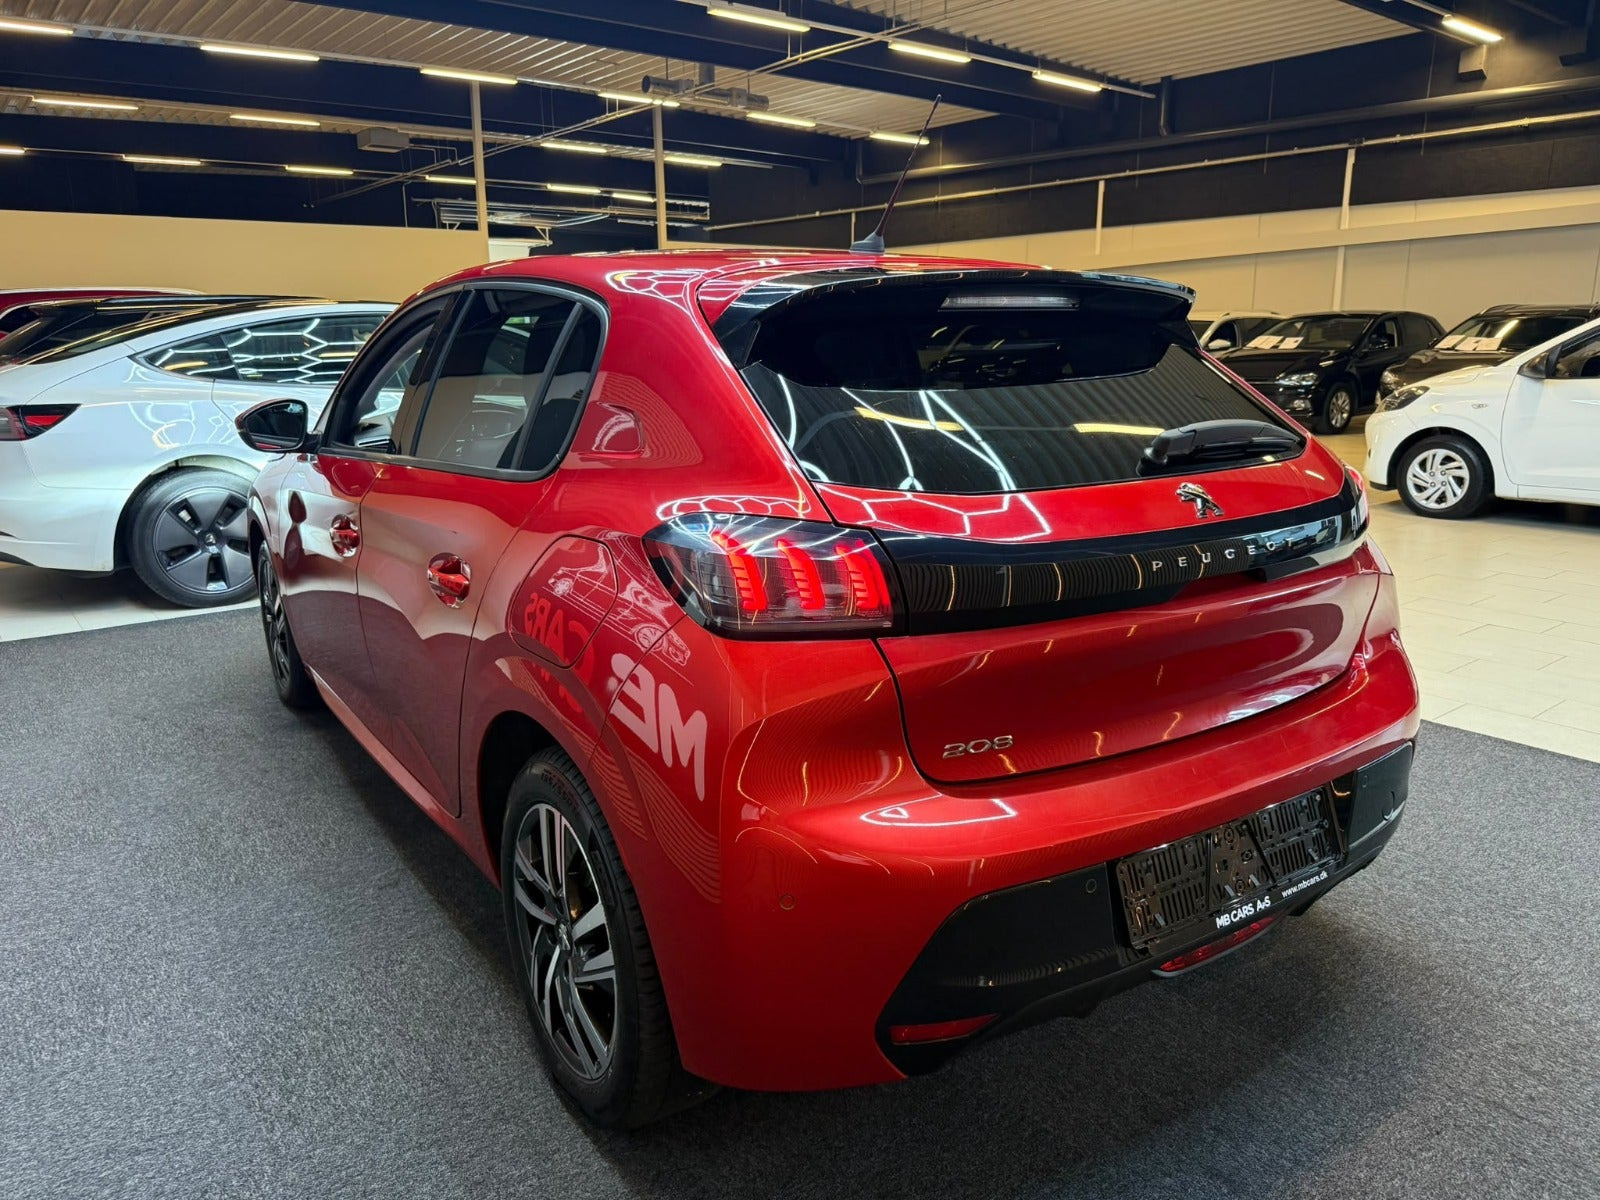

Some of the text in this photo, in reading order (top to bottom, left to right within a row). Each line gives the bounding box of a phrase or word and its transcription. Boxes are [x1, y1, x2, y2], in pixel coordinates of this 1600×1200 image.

[1152, 537, 1294, 572] PEUGEOT
[942, 734, 1013, 759] 208
[1282, 870, 1328, 898] www.mbcars.dk
[1215, 914, 1231, 929] MB
[1231, 904, 1255, 921] CARS
